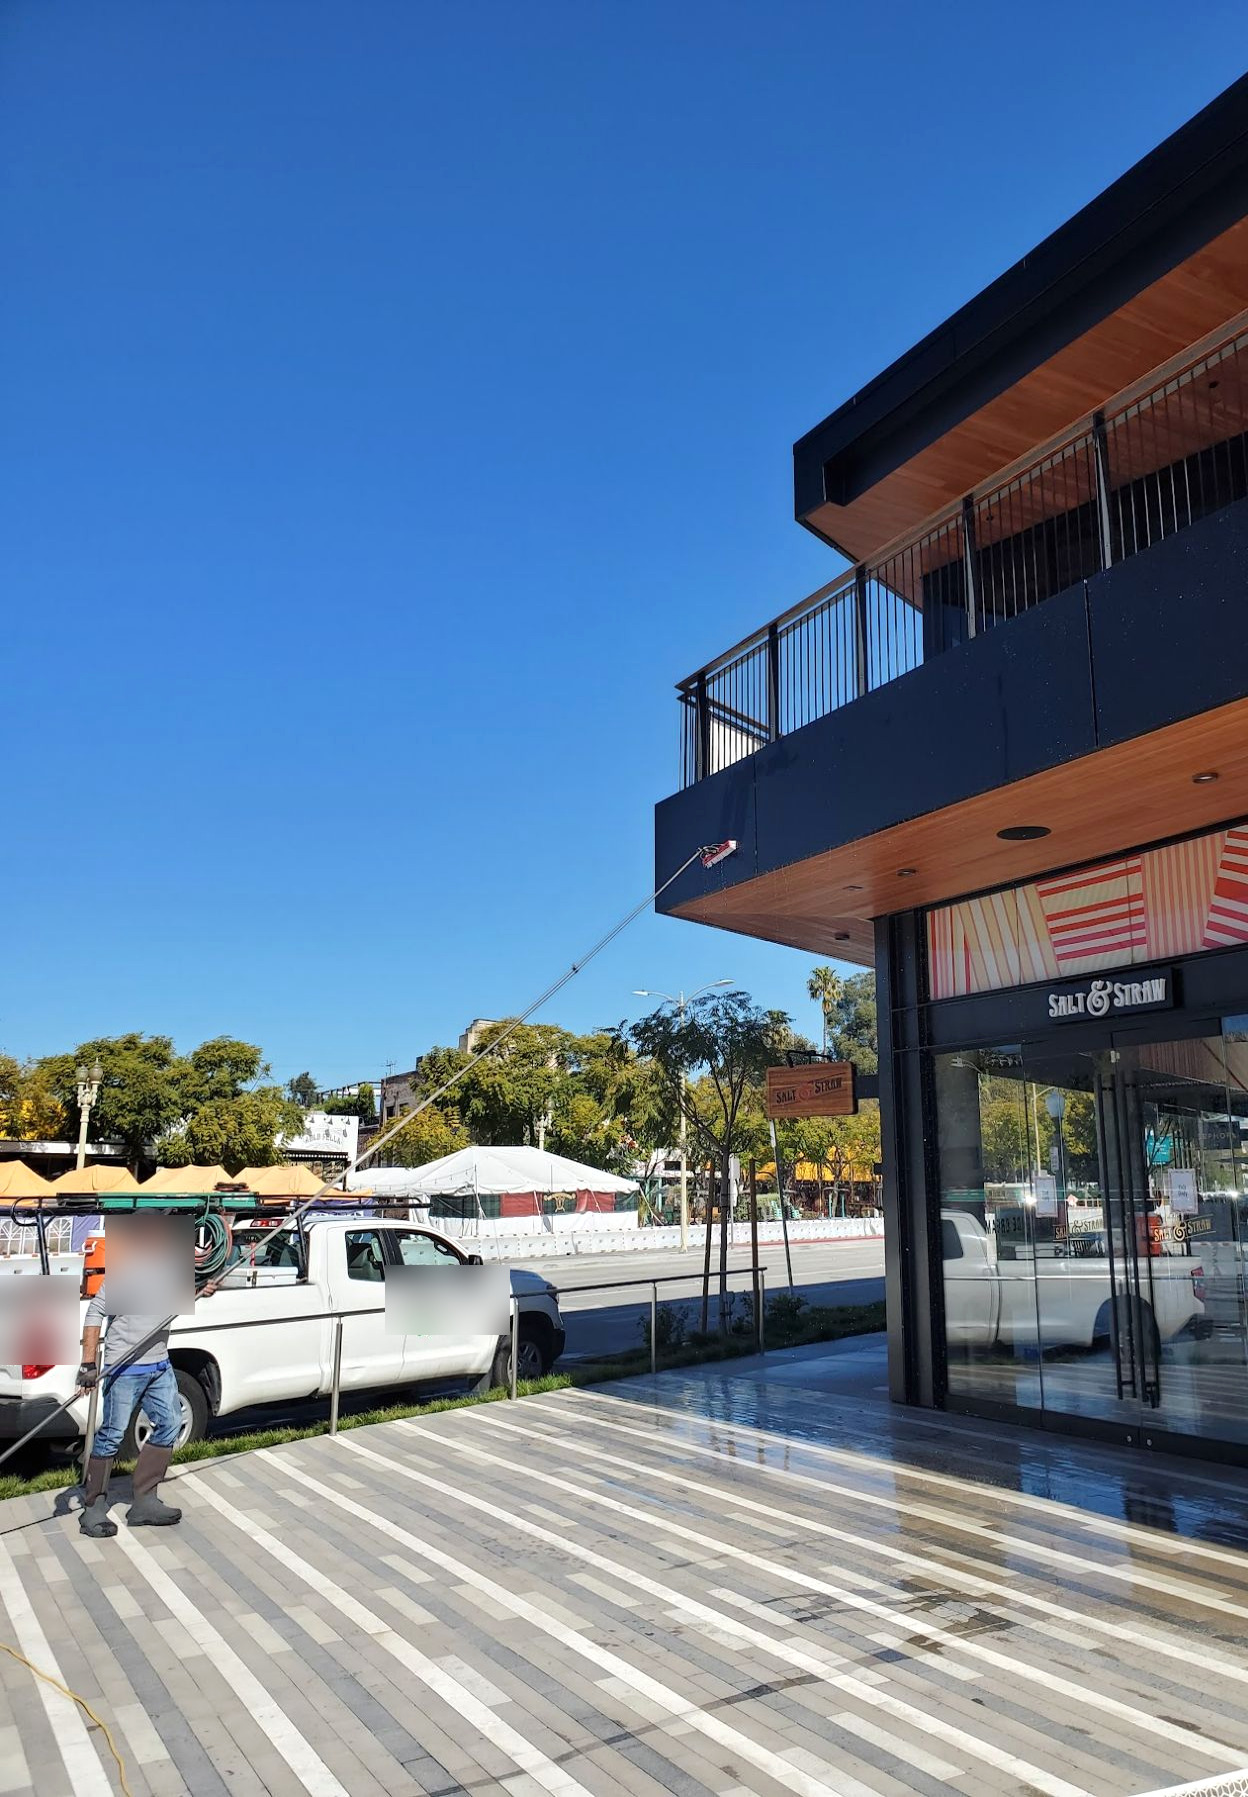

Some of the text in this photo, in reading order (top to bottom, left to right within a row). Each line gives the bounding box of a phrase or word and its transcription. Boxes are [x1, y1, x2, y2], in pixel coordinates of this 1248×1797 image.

[1049, 978, 1166, 1017] SALT & STRAW
[776, 1089, 796, 1103] SALT
[814, 1078, 842, 1094] STRAW
[1173, 1221, 1187, 1242] &
